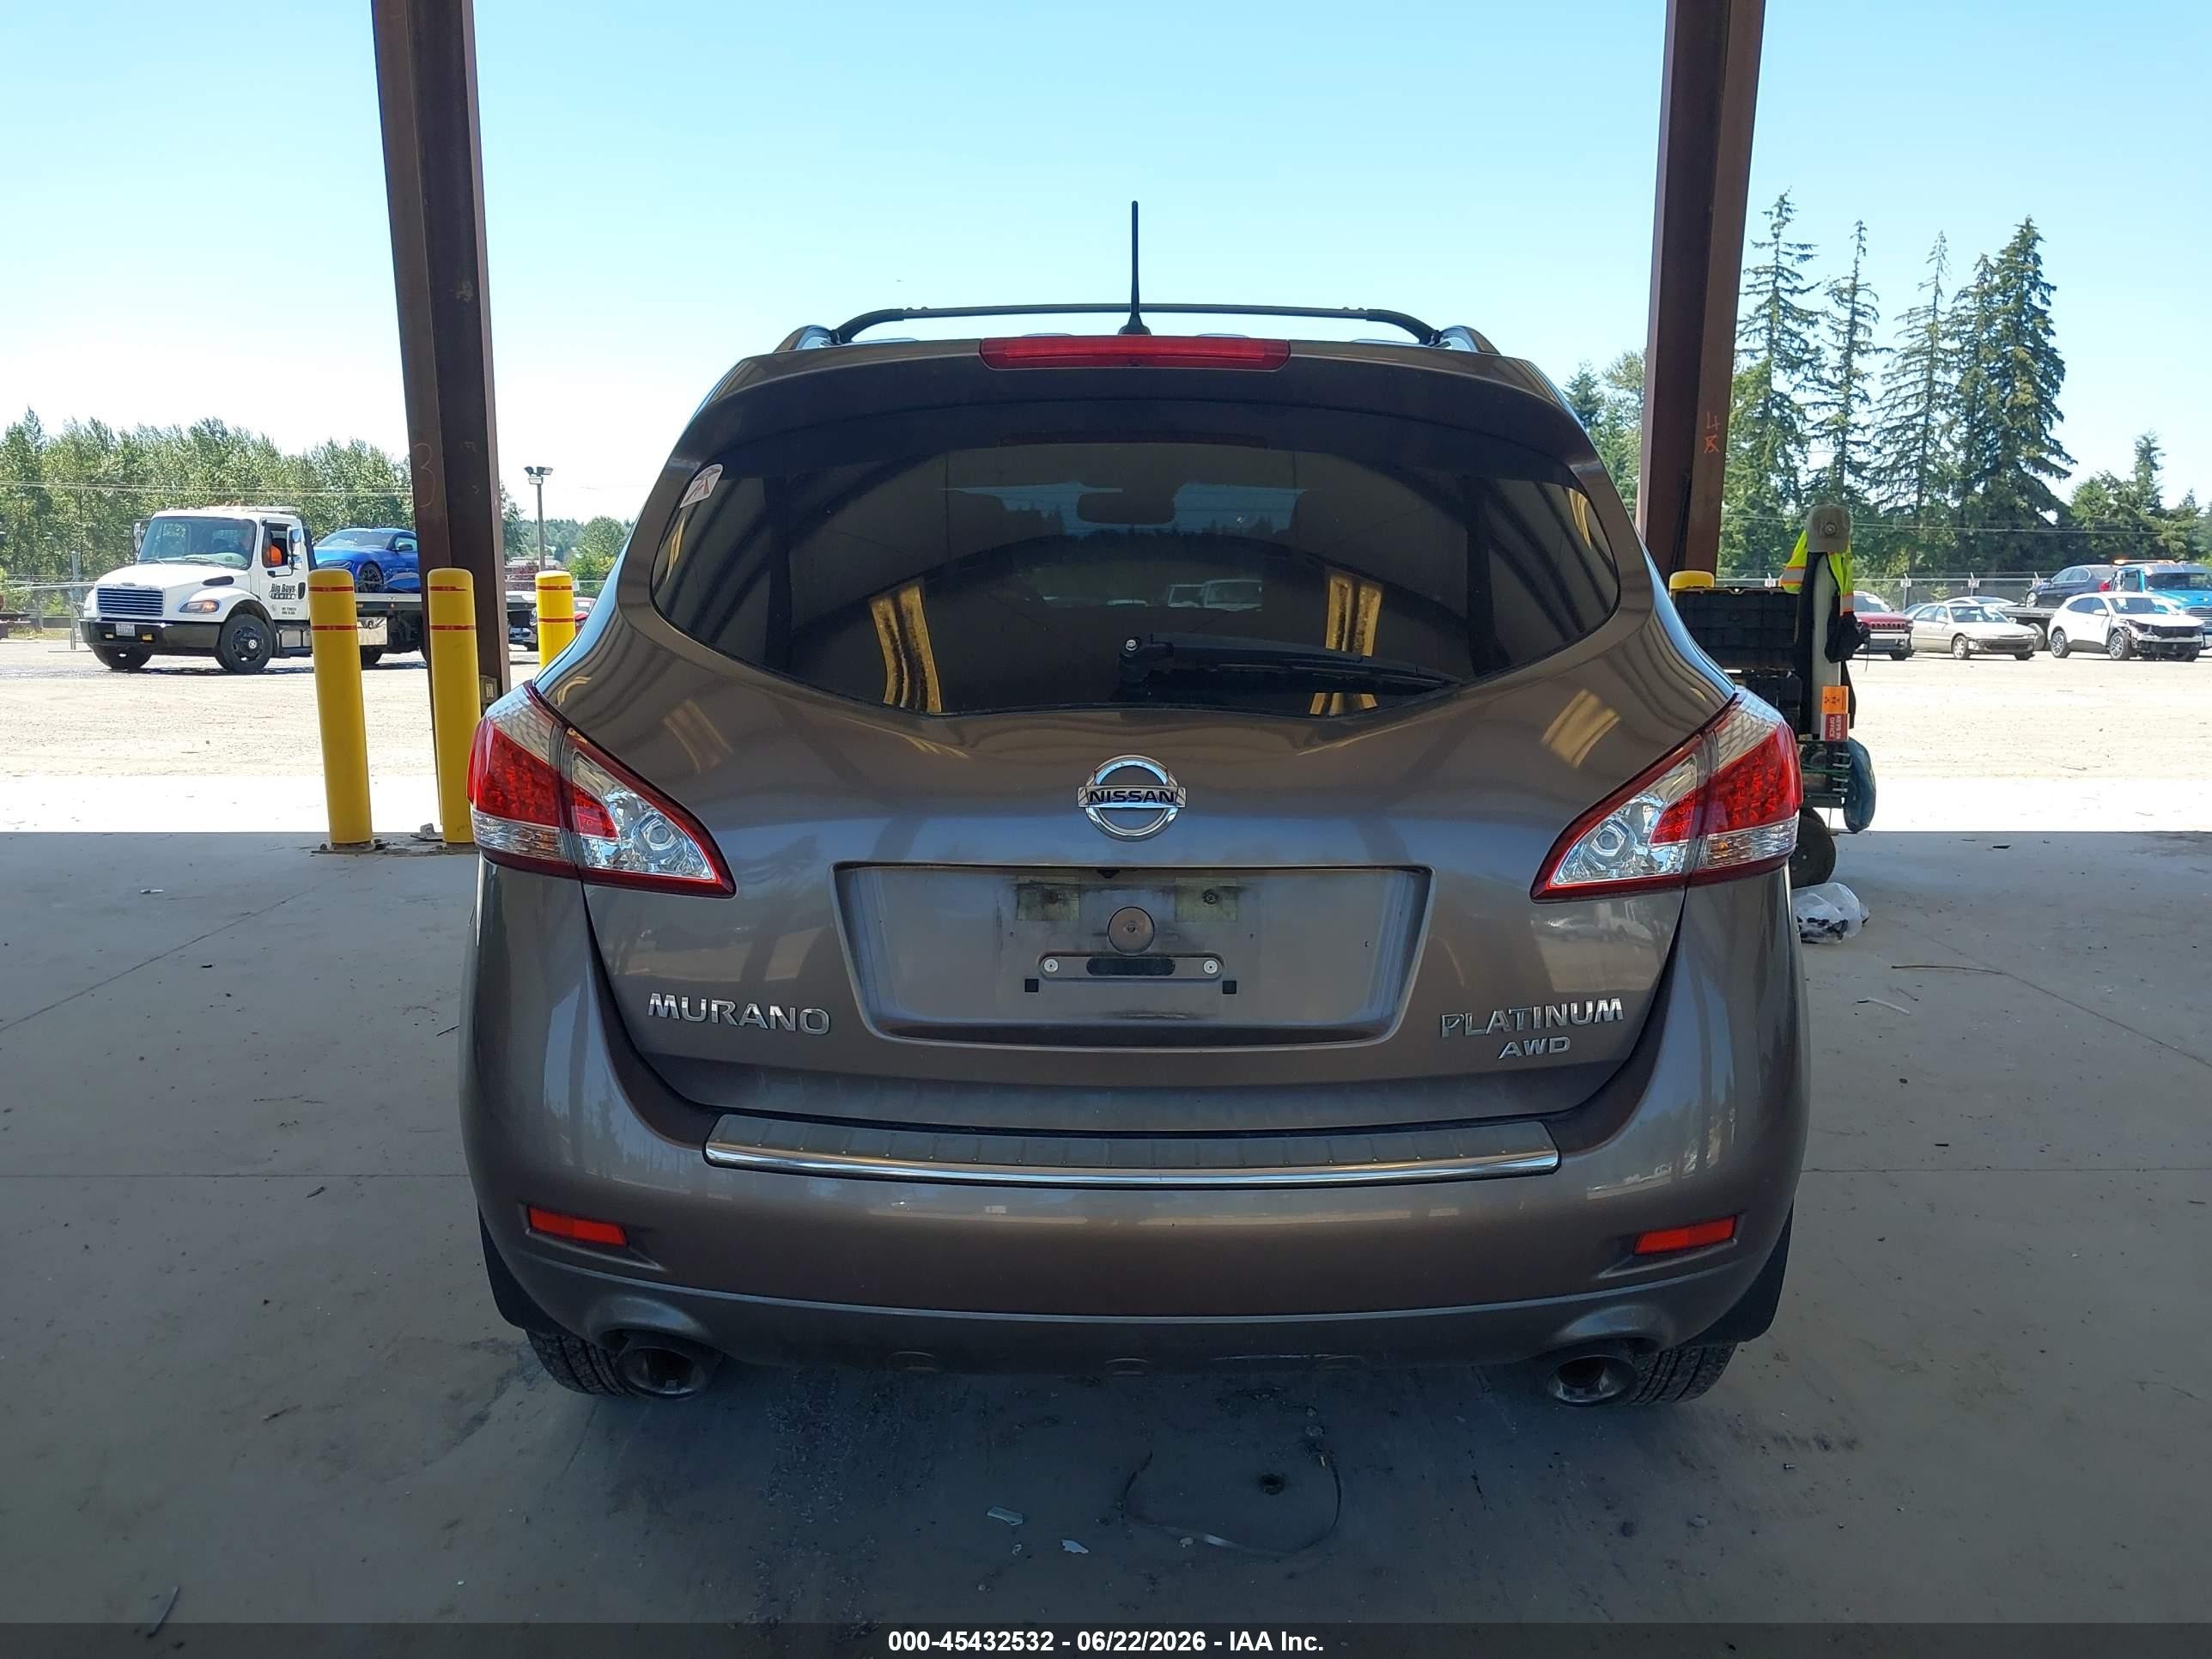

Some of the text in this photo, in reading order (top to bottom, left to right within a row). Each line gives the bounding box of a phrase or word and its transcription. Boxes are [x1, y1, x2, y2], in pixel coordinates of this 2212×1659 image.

[270, 583, 295, 594] Big Boys
[1089, 790, 1175, 803] NISSAN
[647, 992, 830, 1035] MURANO
[1441, 997, 1624, 1038] PLATINUM
[1498, 1036, 1571, 1060] AWD
